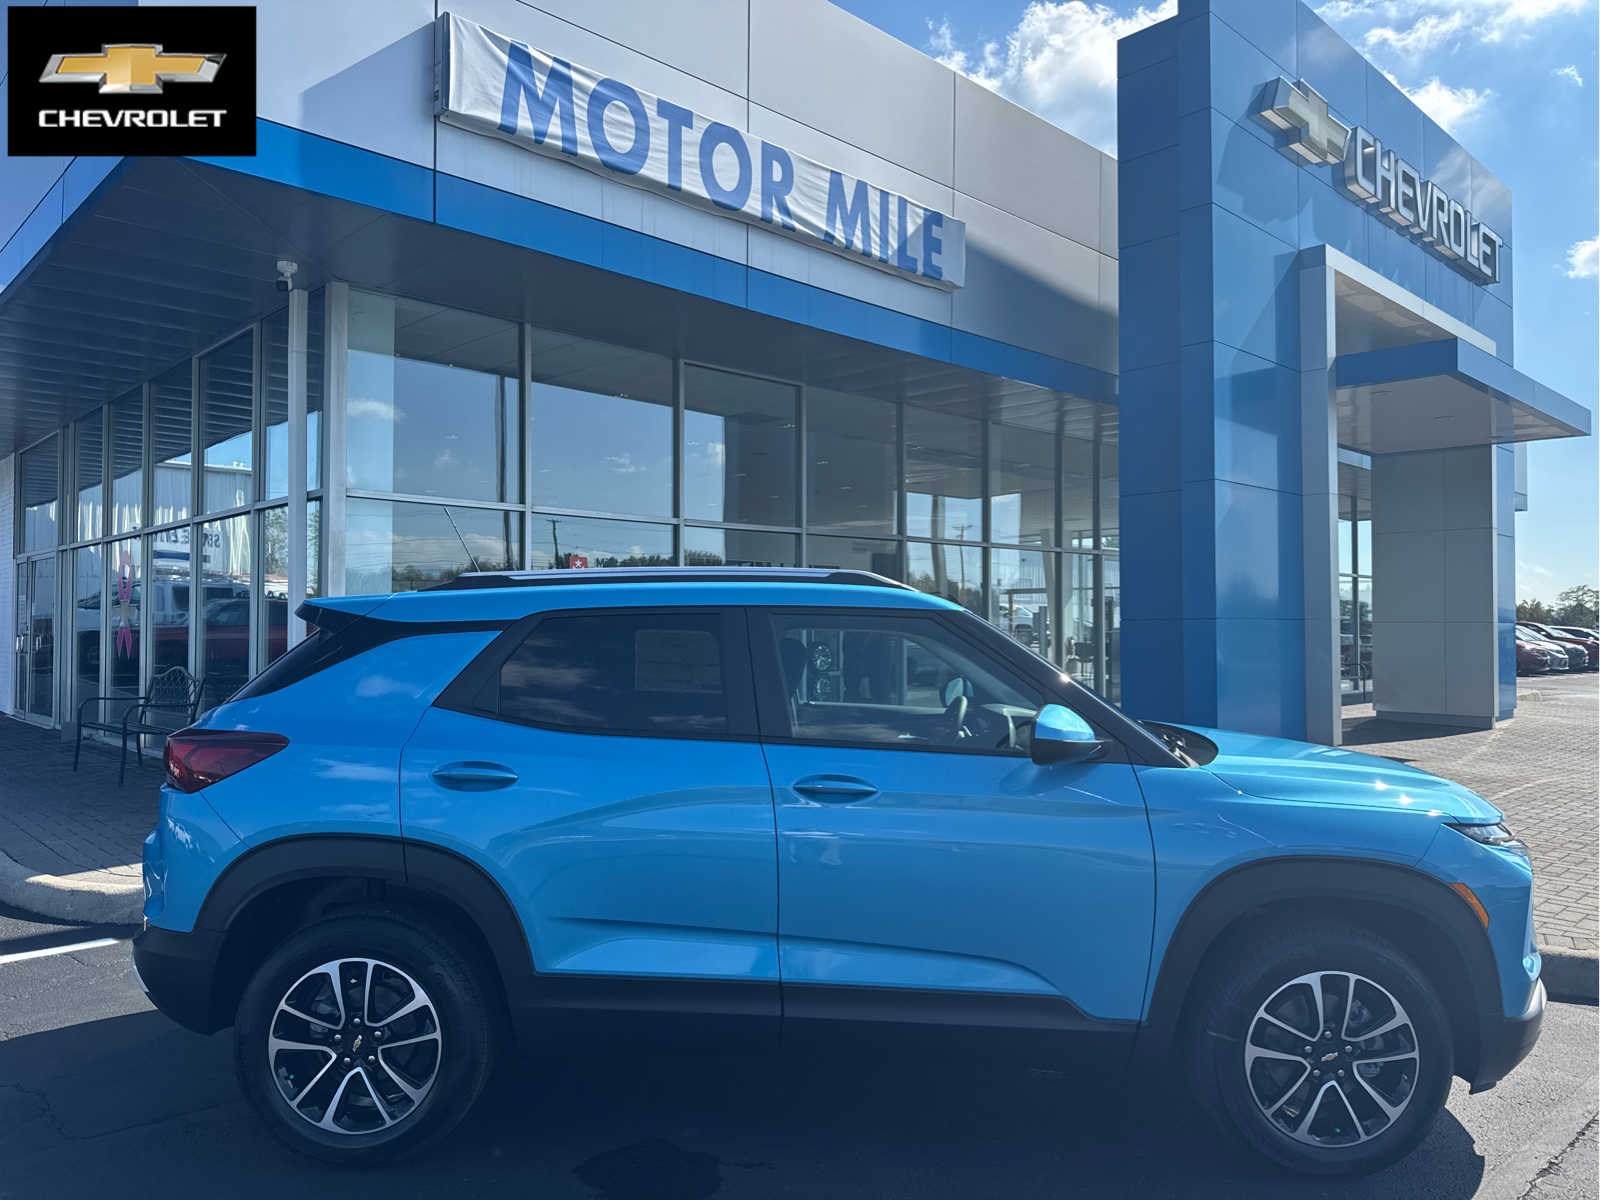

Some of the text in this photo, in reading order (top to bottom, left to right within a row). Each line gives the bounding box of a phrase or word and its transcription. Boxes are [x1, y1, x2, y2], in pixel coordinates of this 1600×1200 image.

[497, 39, 944, 281] MOTOR MILE
[1347, 125, 1503, 284] CHEVROLET
